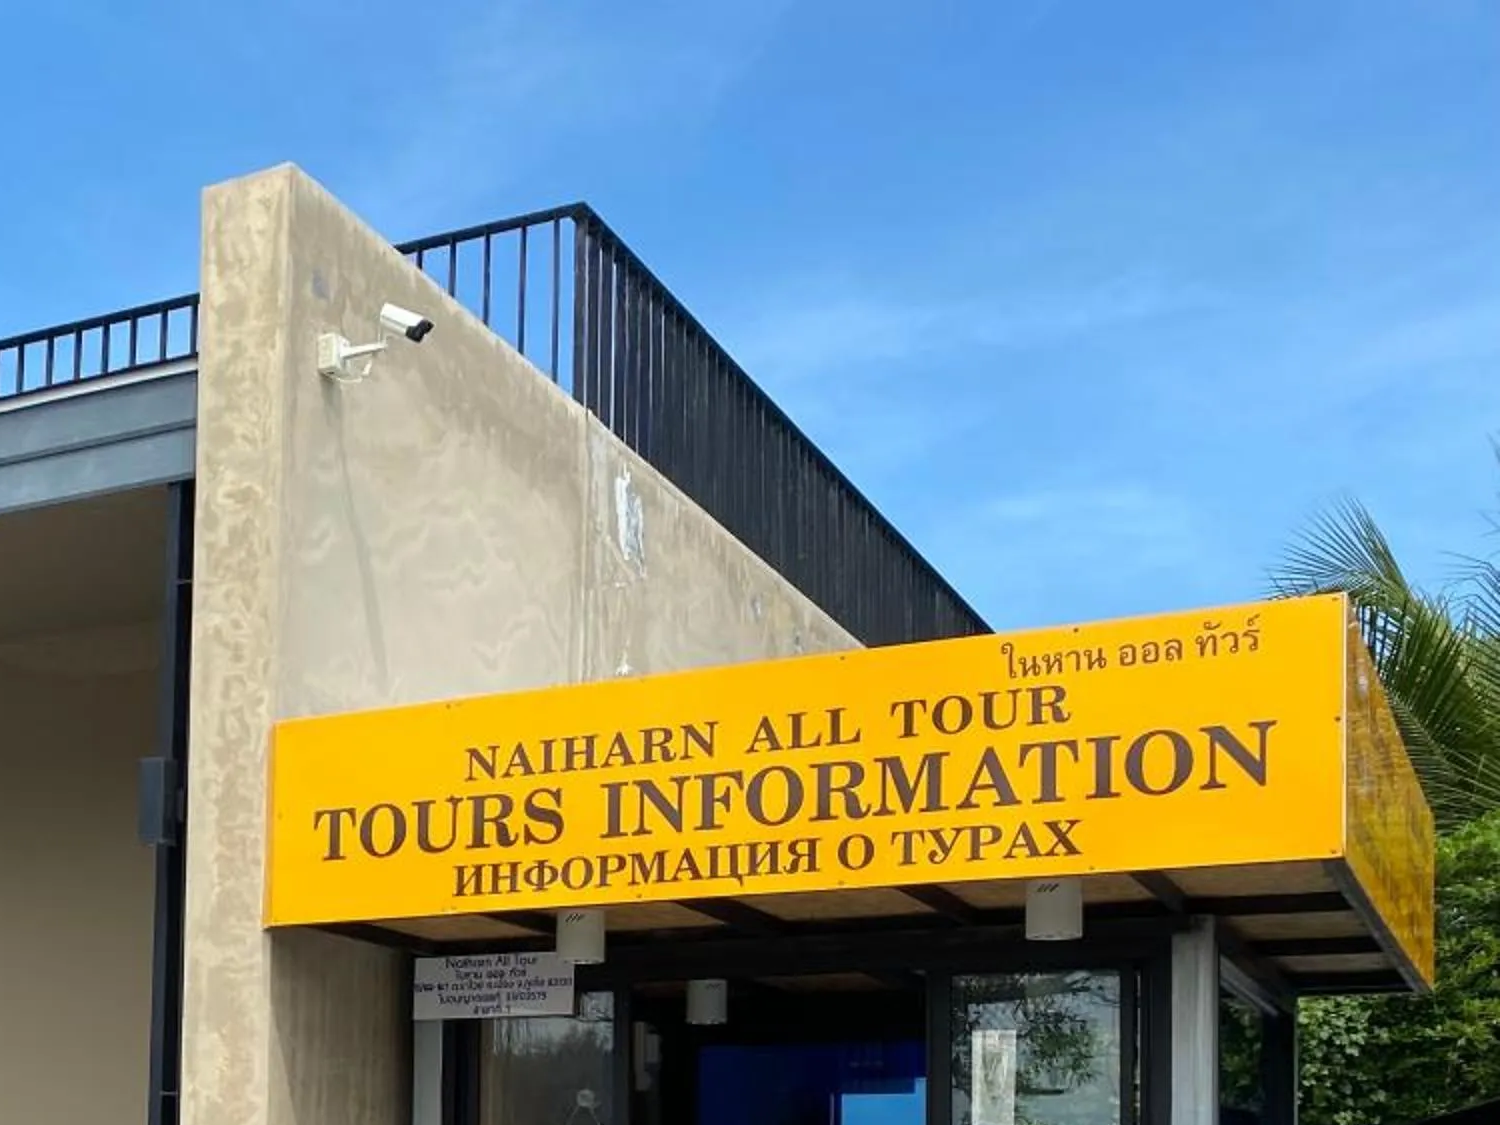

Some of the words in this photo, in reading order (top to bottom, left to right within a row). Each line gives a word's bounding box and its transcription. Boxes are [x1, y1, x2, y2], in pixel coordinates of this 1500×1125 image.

[1000, 643, 1107, 679] ในหาน
[1118, 637, 1184, 666] ออล
[1195, 613, 1262, 658] ทัวร์
[464, 720, 720, 783] NAIHARN
[744, 706, 862, 755] ALL
[889, 684, 1072, 740] TOUR
[312, 786, 566, 862] TOURS
[598, 719, 1278, 840] INFORMATION
[452, 836, 822, 898] ИНФОРМАЦИЯ
[837, 833, 876, 872] О
[890, 818, 1084, 867] ТУРАХ
